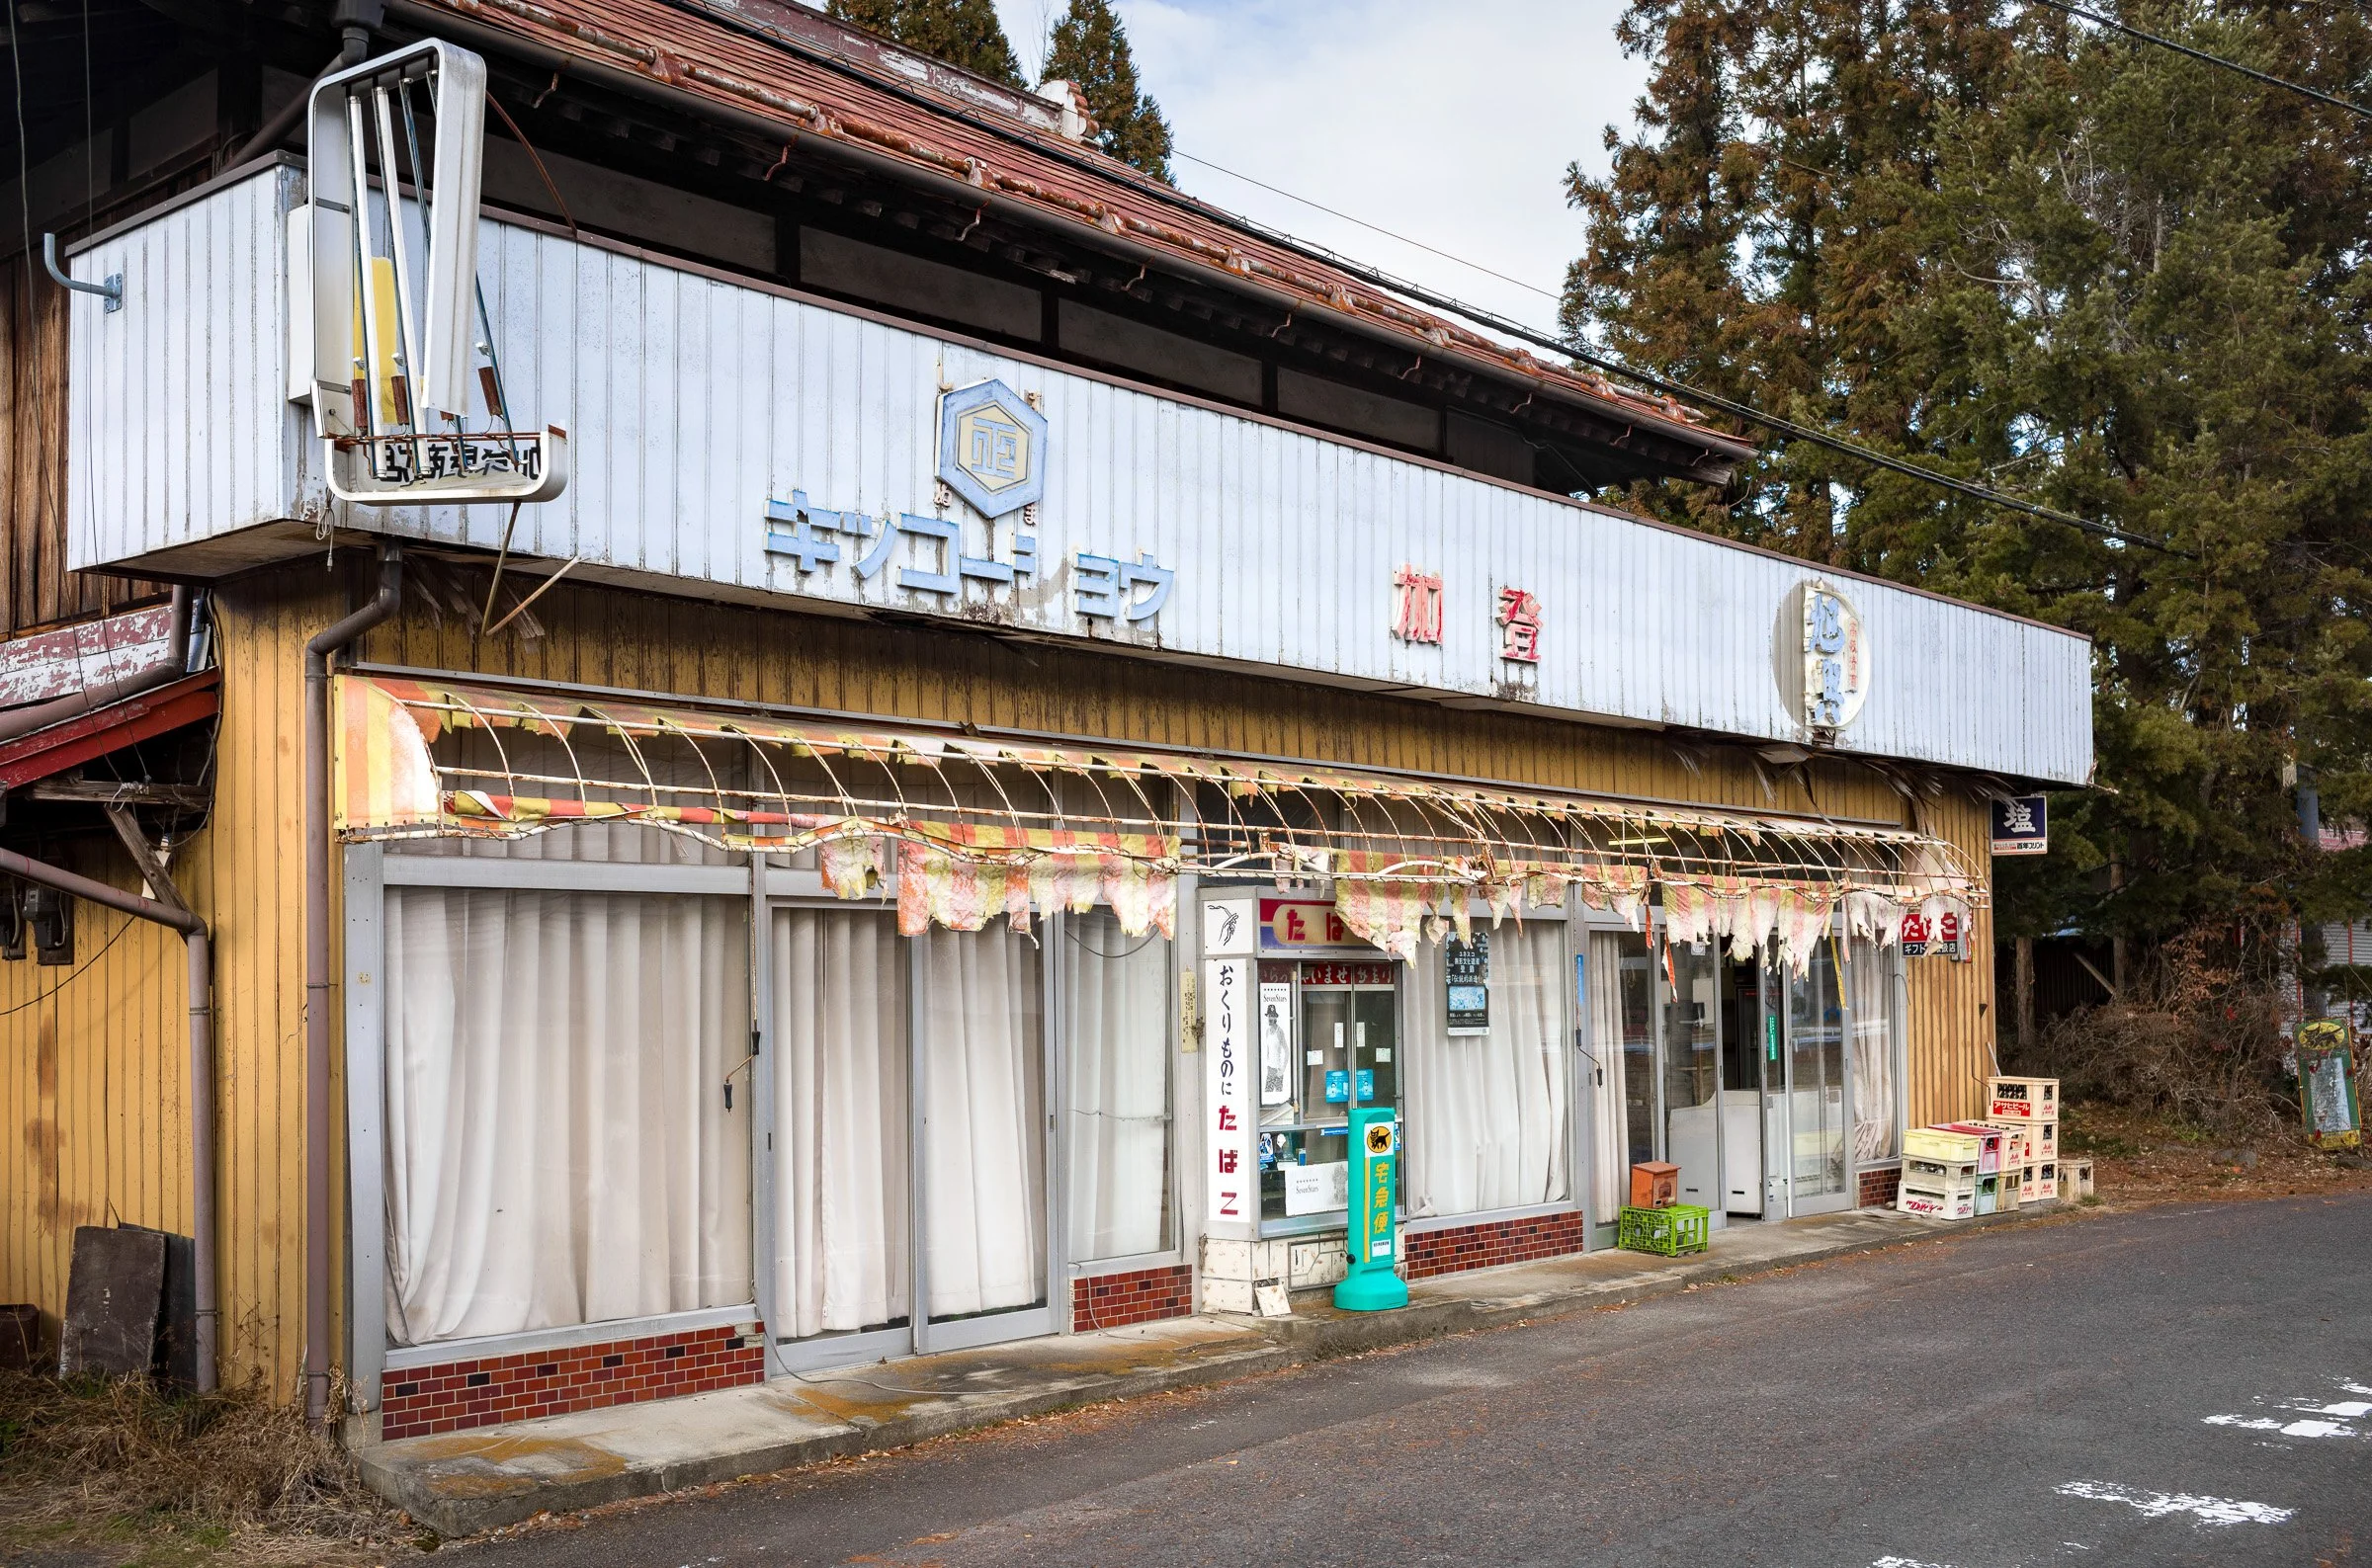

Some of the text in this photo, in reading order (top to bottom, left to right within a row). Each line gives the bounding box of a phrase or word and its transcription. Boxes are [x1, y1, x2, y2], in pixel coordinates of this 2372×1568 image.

[2003, 804, 2036, 833] 塩
[1904, 918, 1957, 938] たこ
[1994, 1102, 2030, 1111] アサヒビール
[1374, 1162, 1390, 1234] 宅急便
